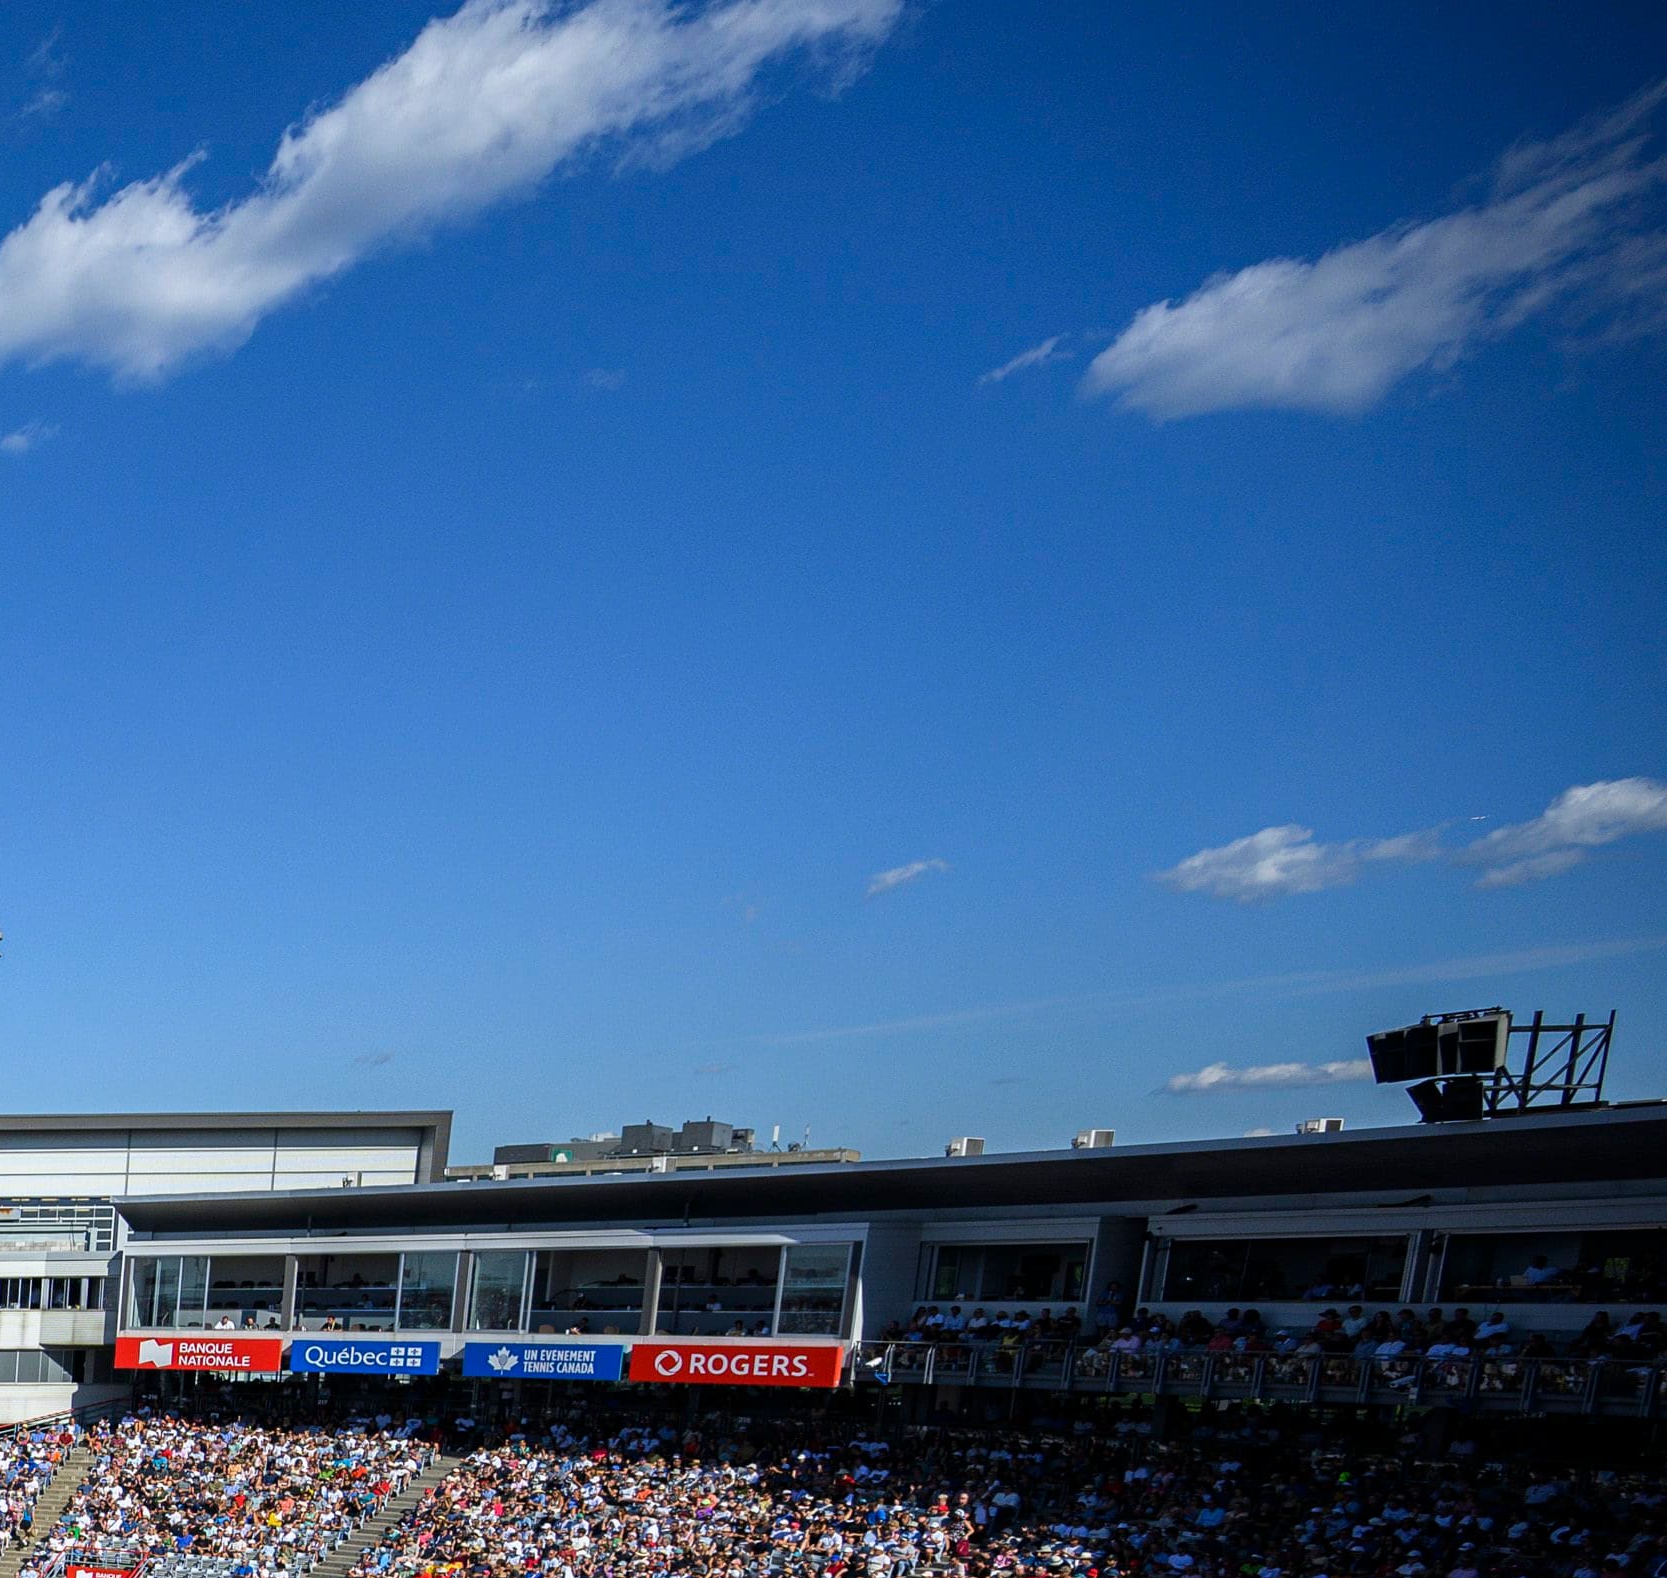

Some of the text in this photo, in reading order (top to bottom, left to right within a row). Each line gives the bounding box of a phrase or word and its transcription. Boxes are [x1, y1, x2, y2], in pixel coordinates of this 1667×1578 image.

[179, 1342, 233, 1355] BANQUE
[524, 1349, 538, 1361] UN
[178, 1354, 251, 1367] NATIONALE
[305, 1345, 388, 1368] Québec
[523, 1361, 595, 1375] TENNIS CANADA
[688, 1353, 808, 1377] ROGERS
